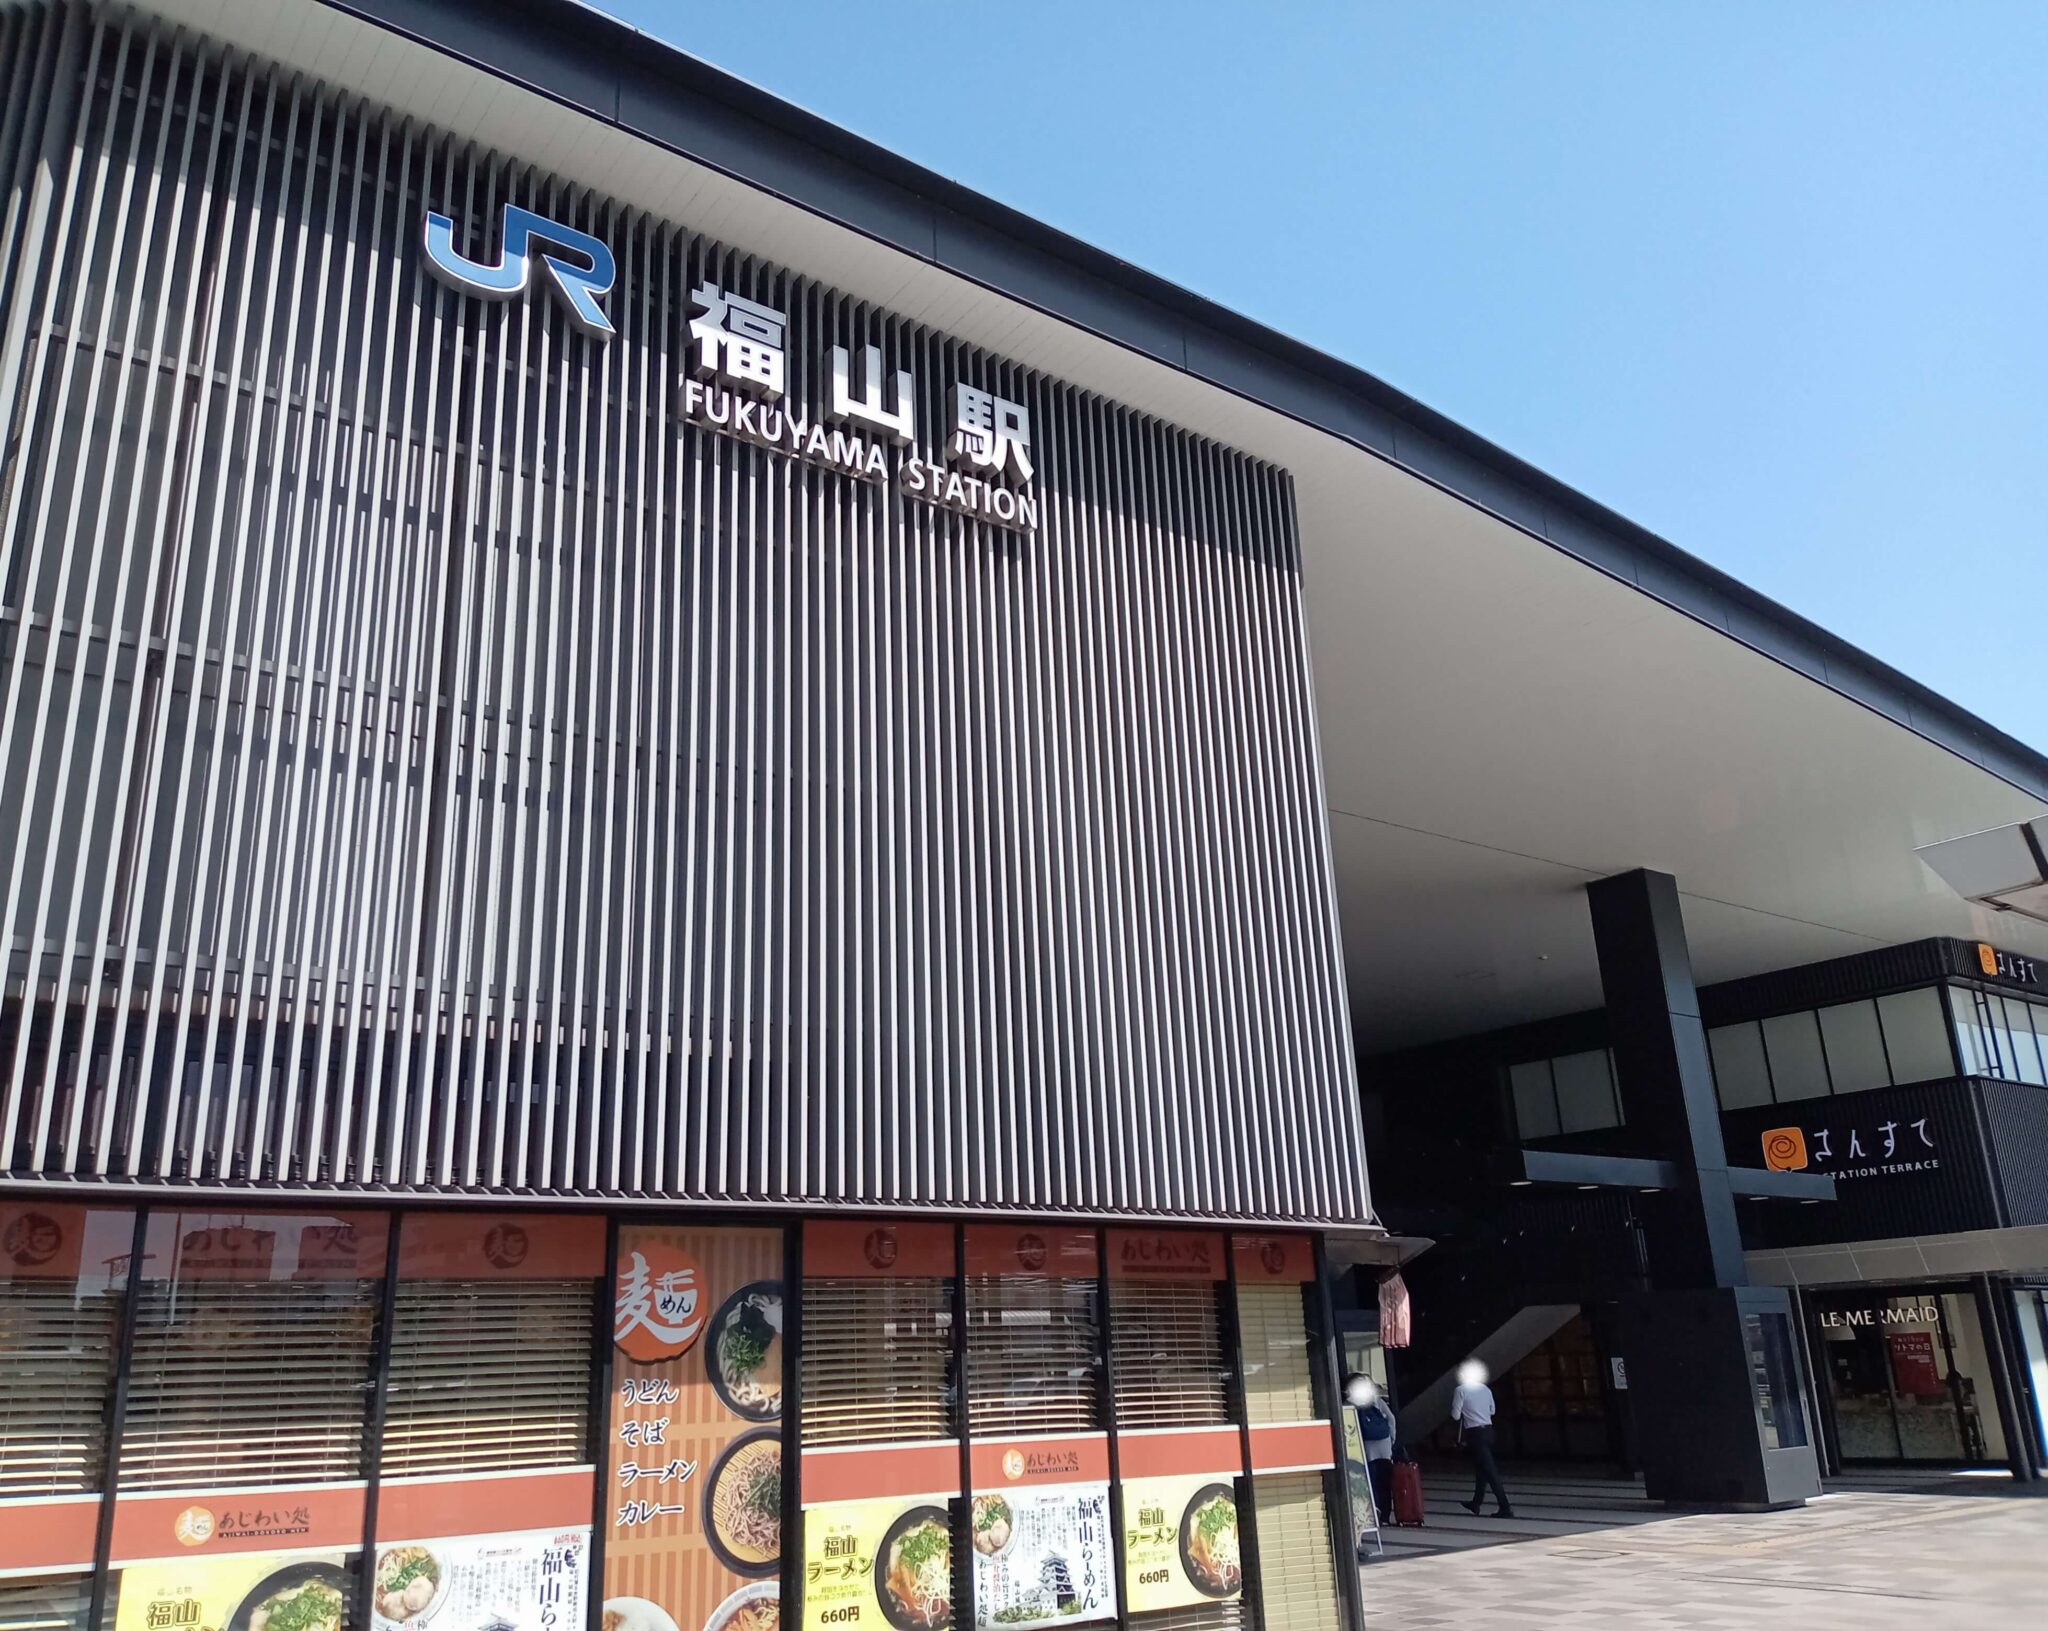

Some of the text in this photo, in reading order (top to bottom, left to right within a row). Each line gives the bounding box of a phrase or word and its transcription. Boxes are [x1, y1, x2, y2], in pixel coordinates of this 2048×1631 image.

[424, 202, 617, 334] JR
[688, 280, 1035, 484] 福山駅
[685, 382, 1039, 530] FUKUYAMA STATION
[1813, 1117, 1934, 1163] さんすて
[1880, 1159, 1941, 1175] TERRACE
[660, 1295, 692, 1315] めん
[620, 1378, 680, 1407] うどん
[619, 1418, 669, 1448] そば
[617, 1459, 698, 1488] ラーメン
[218, 1506, 311, 1529] あじわい処
[616, 1500, 685, 1526] カレー
[1138, 1507, 1165, 1528] 福山
[824, 1535, 858, 1559] 福山
[1127, 1527, 1178, 1549] ラーメン
[1078, 1497, 1099, 1610] 福山らーめん
[807, 1557, 874, 1583] ラーメン
[1139, 1569, 1170, 1585] 660円
[540, 1548, 563, 1631] 福山ら
[148, 1599, 202, 1630] 福山
[821, 1606, 860, 1624] 660円
